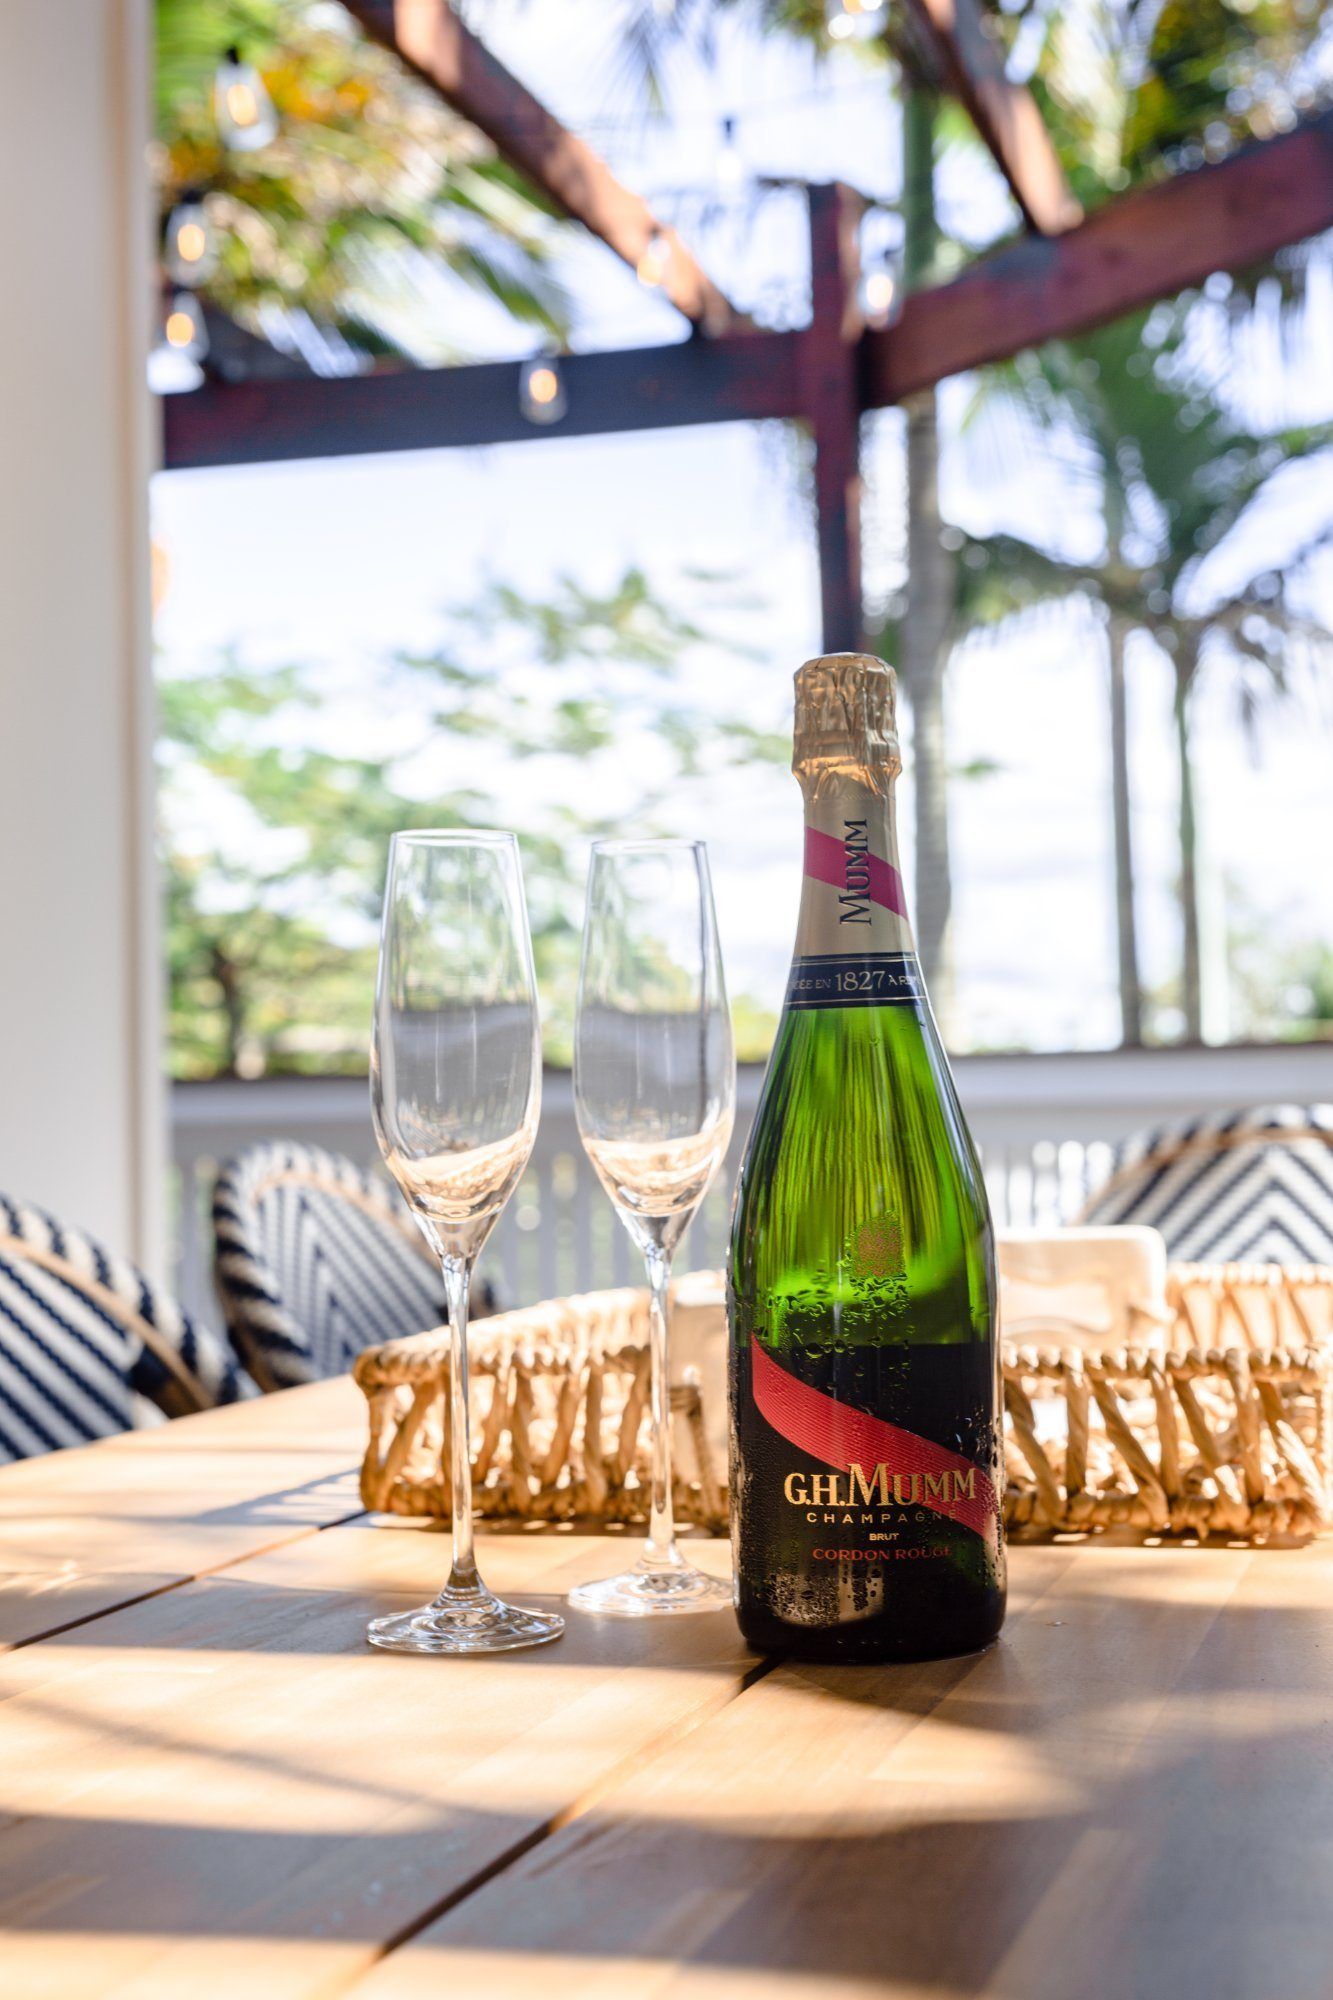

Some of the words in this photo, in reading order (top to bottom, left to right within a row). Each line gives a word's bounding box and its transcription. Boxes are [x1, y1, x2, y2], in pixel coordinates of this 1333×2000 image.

[835, 970, 886, 992] 1827
[806, 1509, 958, 1525] CHAMPAGNE
[869, 1532, 900, 1541] BRUT
[812, 1547, 890, 1561] CORDON
